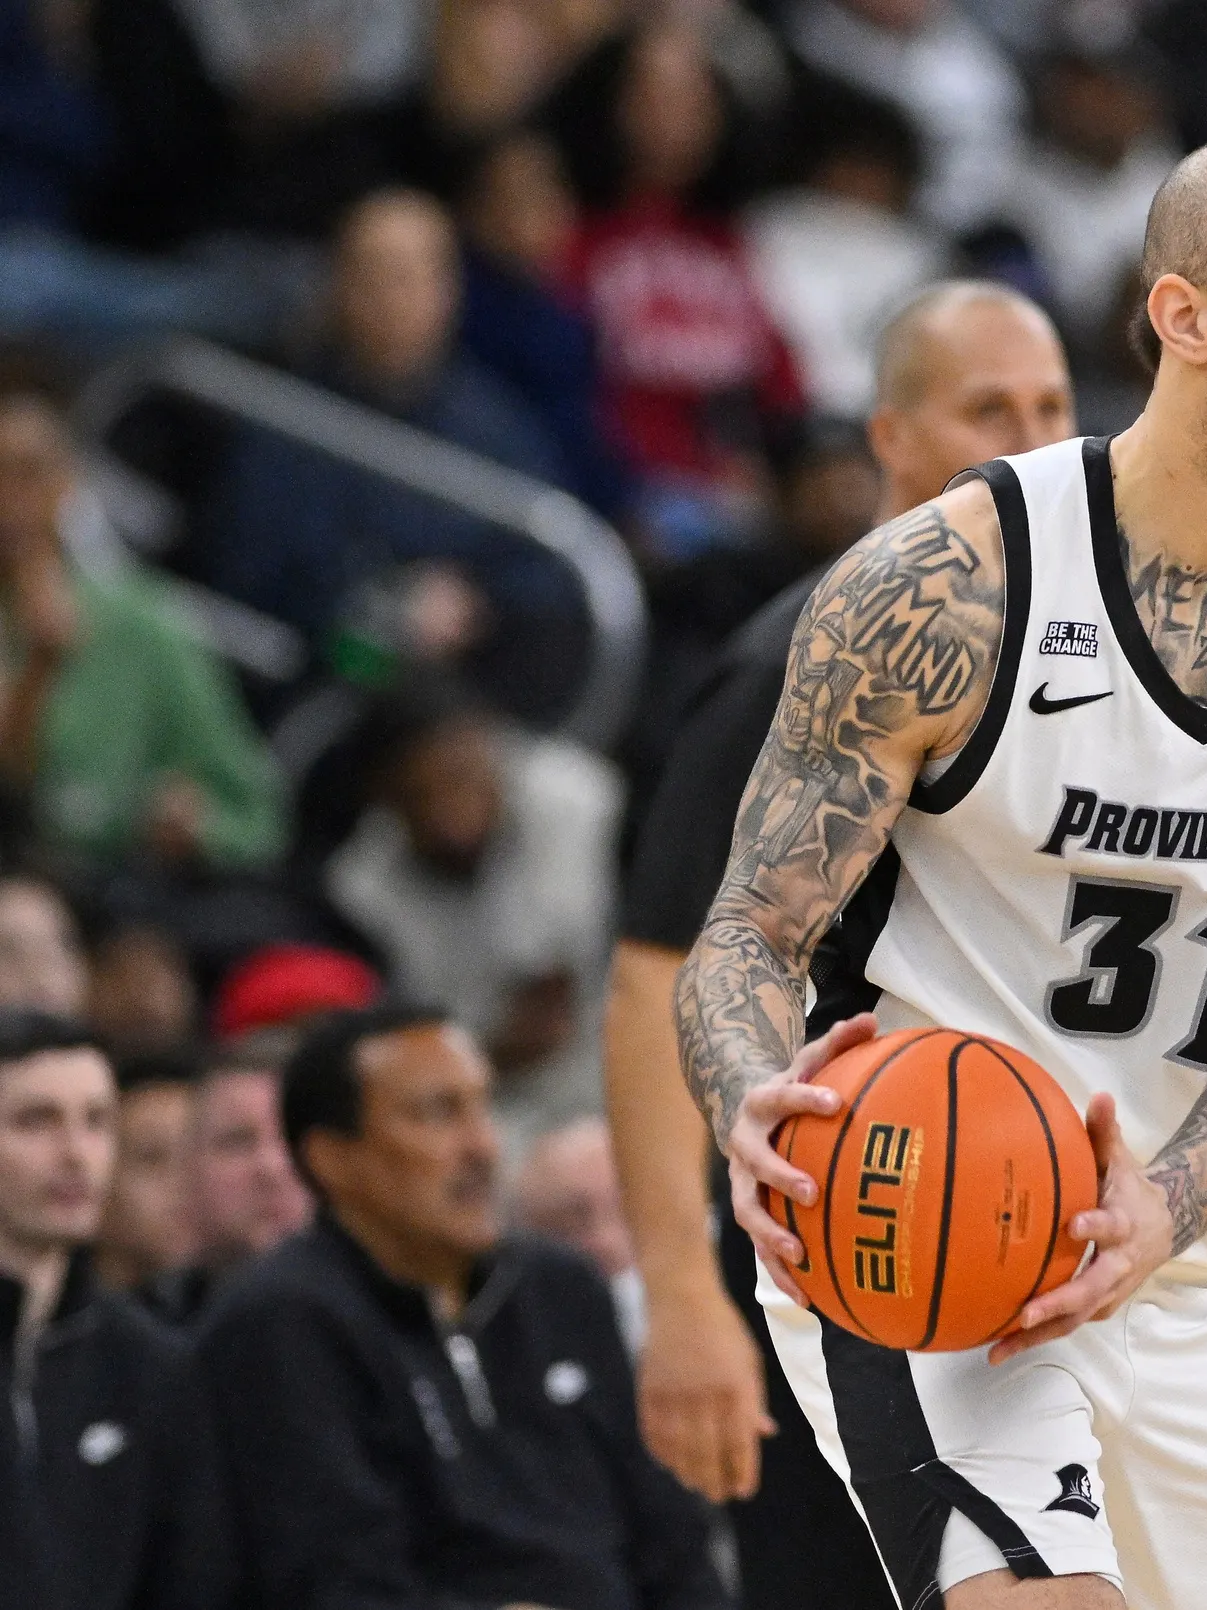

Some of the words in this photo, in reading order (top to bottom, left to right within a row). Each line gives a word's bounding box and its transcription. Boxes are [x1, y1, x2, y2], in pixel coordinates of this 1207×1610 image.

[849, 575, 976, 716] MIND
[1040, 638, 1098, 656] CHANGE
[1047, 623, 1069, 638] BE
[1073, 624, 1097, 640] THE
[854, 1121, 911, 1294] ELITE
